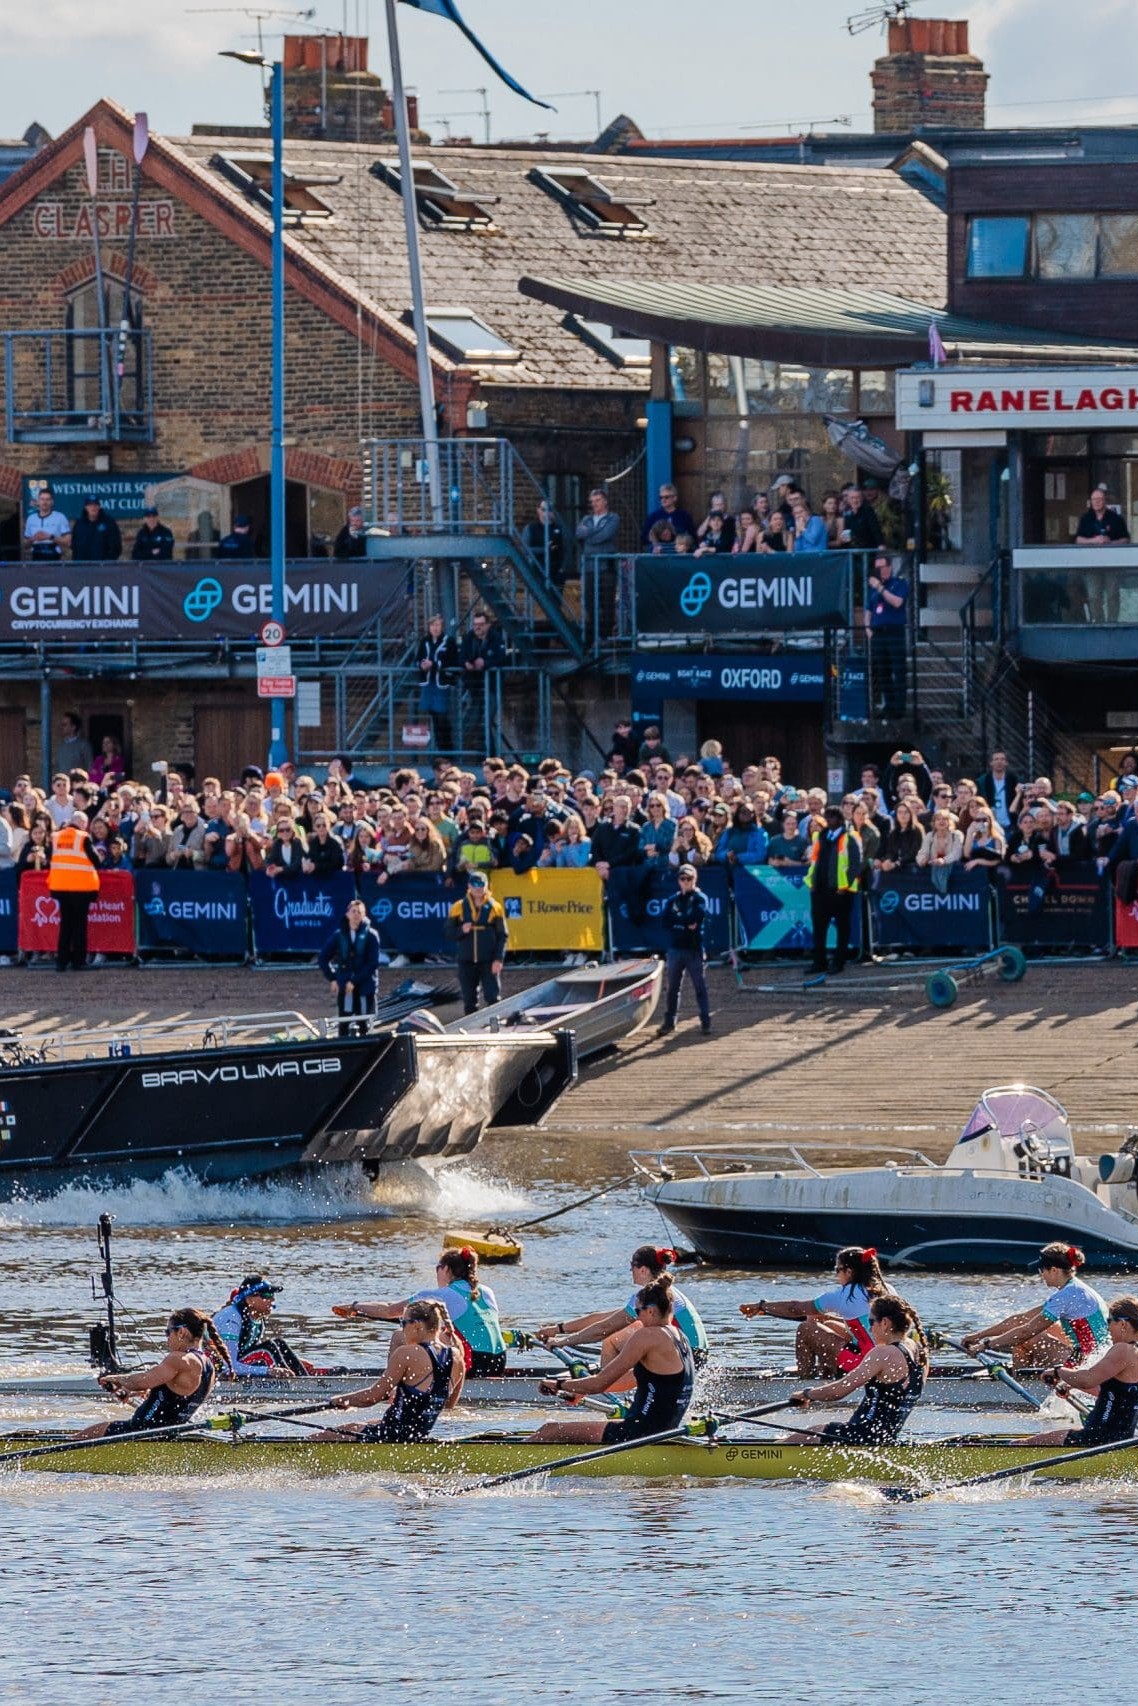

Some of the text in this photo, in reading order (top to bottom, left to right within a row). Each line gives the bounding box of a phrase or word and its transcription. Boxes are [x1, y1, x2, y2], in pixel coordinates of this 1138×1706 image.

[34, 204, 174, 238] CLASPER
[53, 481, 137, 496] WESTMINSTER
[9, 585, 140, 617] GEMINI
[231, 582, 359, 614] GEMINI
[717, 576, 813, 609] GEMINI
[11, 618, 140, 630] CRYPTOCURRENCY EXCHANGE
[264, 628, 281, 640] 20
[720, 668, 782, 690] OXFORD
[99, 901, 125, 911] Heart
[168, 901, 237, 920] GEMINI
[274, 887, 333, 928] Graduate
[904, 893, 980, 911] GEMINI
[87, 912, 121, 922] ndation
[142, 1058, 342, 1088] BRAVO LIMA GB
[254, 1381, 290, 1389] GEMINI
[741, 1450, 783, 1460] GEMINI
